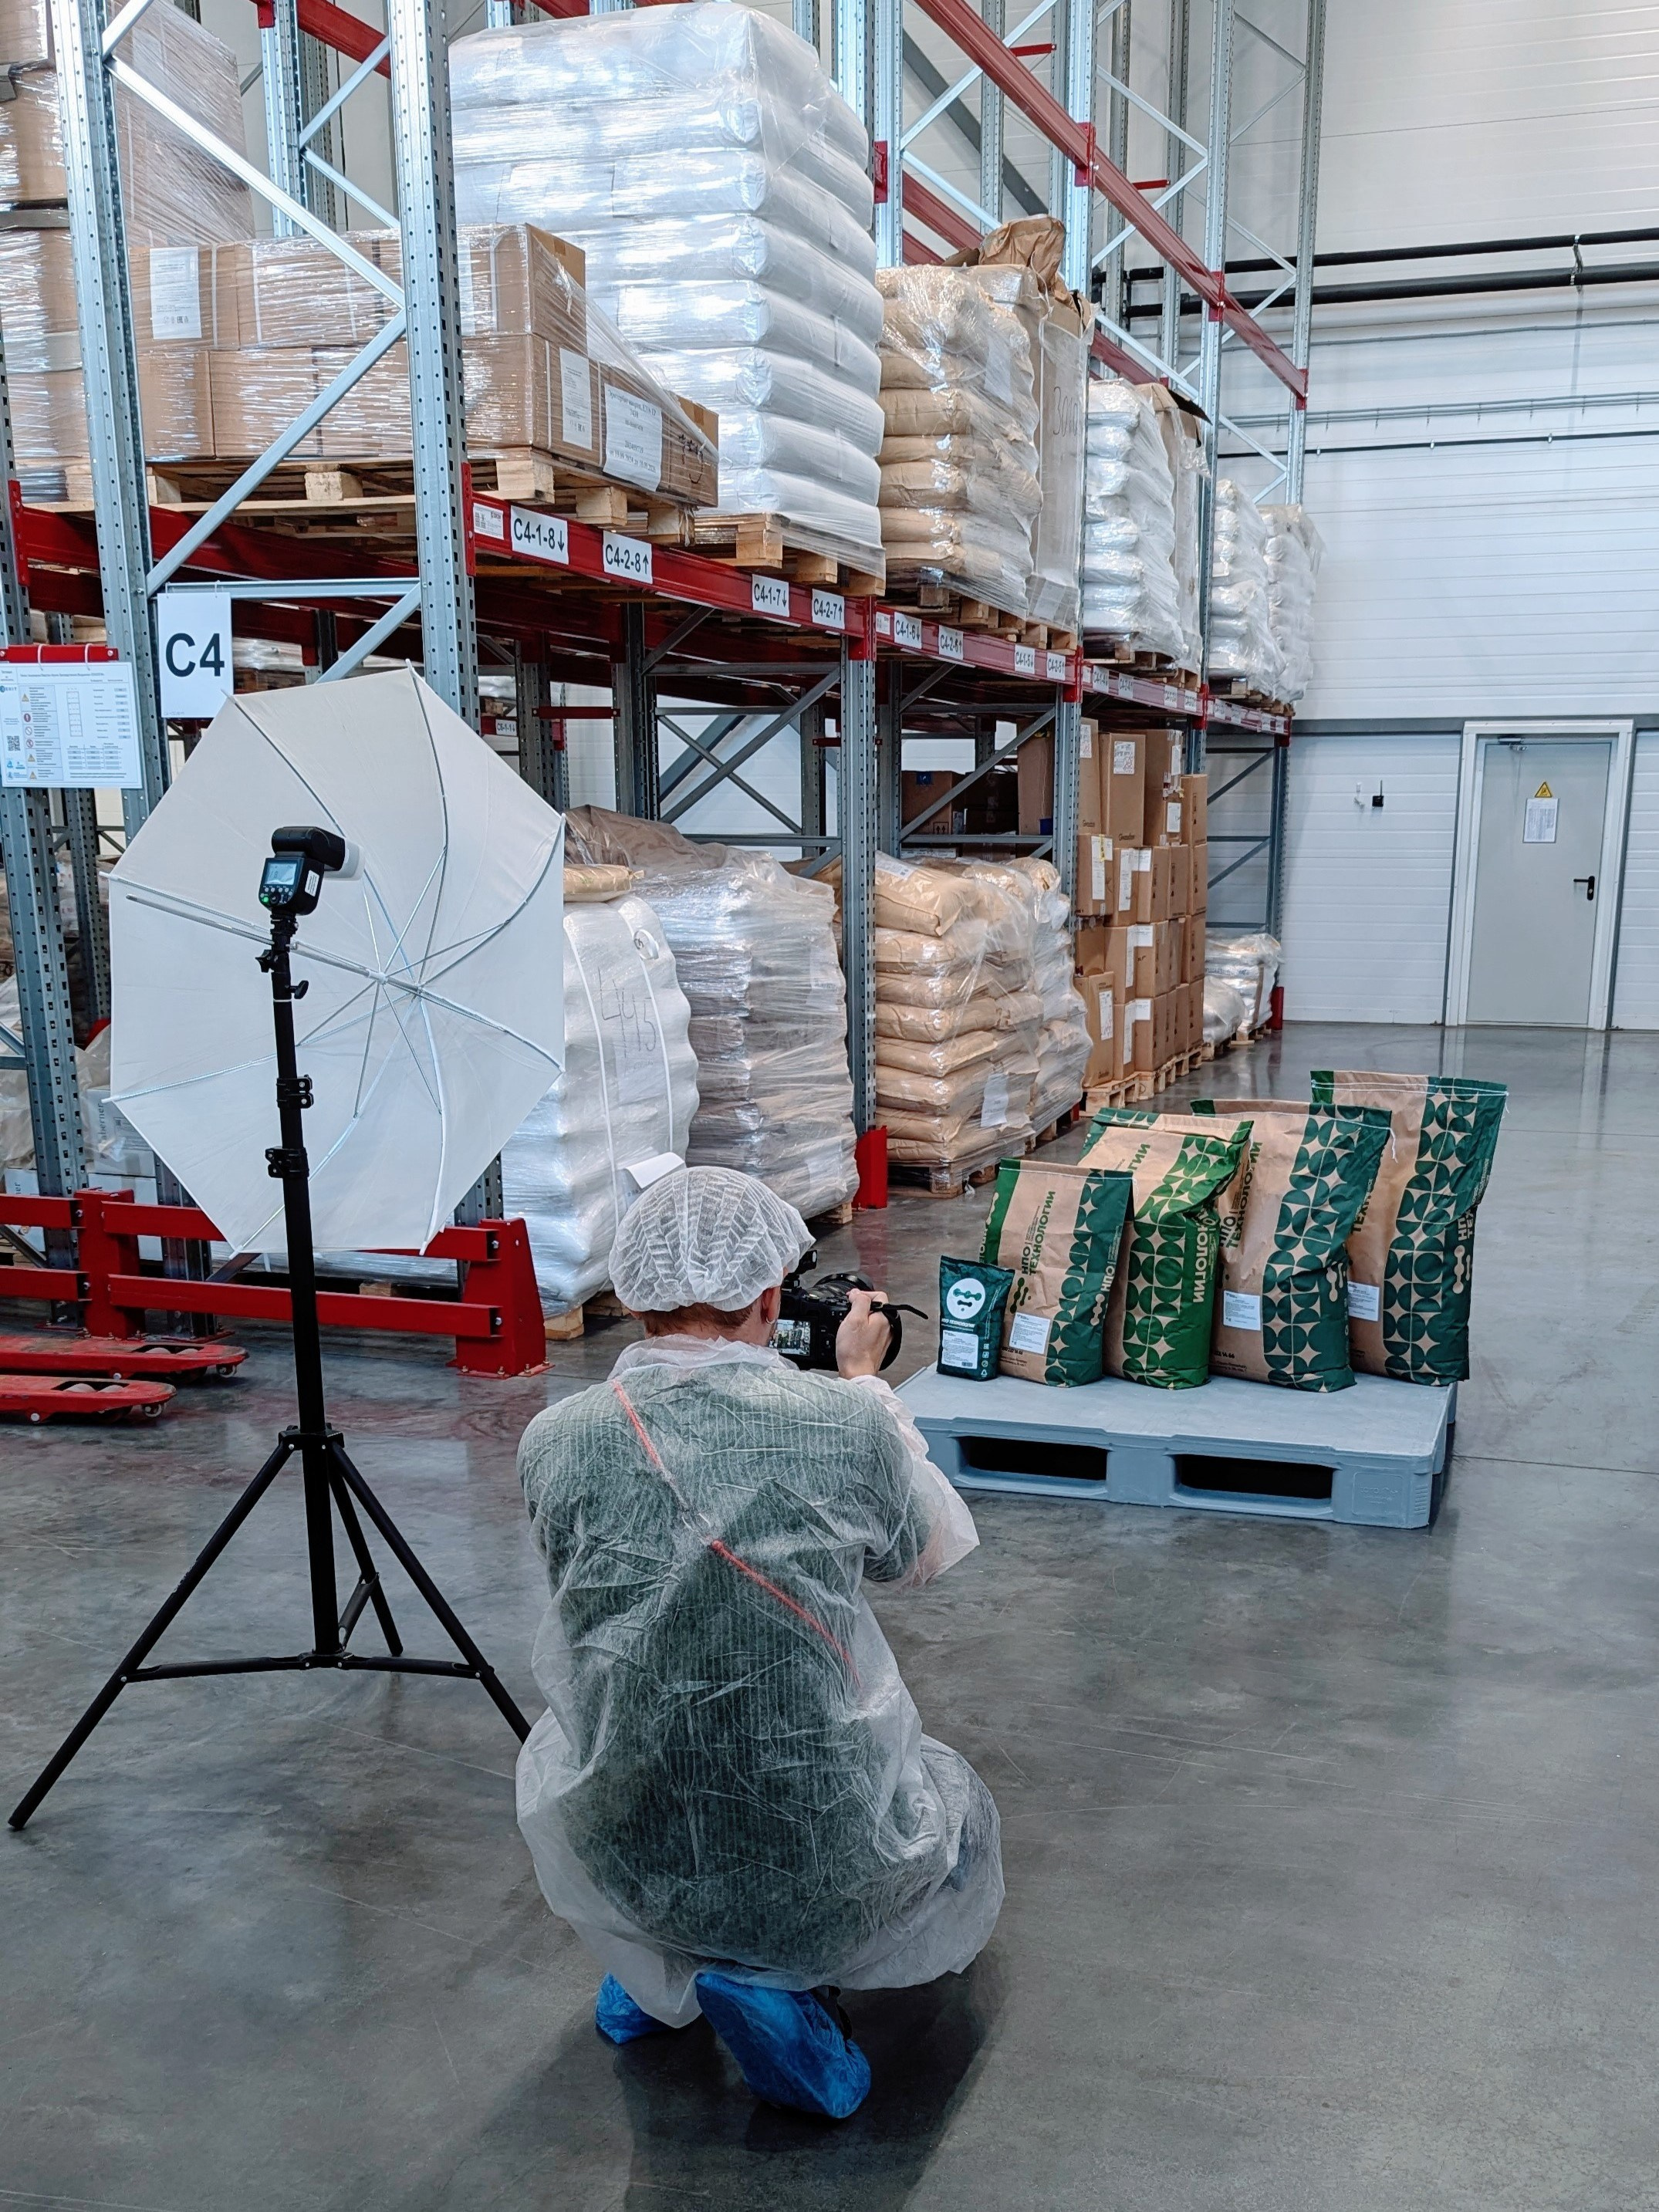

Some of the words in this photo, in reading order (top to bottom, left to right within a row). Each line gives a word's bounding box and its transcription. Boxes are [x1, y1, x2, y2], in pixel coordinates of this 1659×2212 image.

[513, 518, 556, 549] C4-1-8
[605, 544, 641, 573] C4-2-8
[754, 583, 781, 606] C4-1-7
[813, 598, 838, 620] C4-2-7
[165, 633, 225, 677] C4
[98, 1103, 107, 1140] aberner
[1029, 1190, 1056, 1276] ТЕХНОЛОГИИ
[1458, 1214, 1468, 1241] НП
[1022, 1245, 1032, 1275] НПО
[1100, 1265, 1114, 1292] НПО
